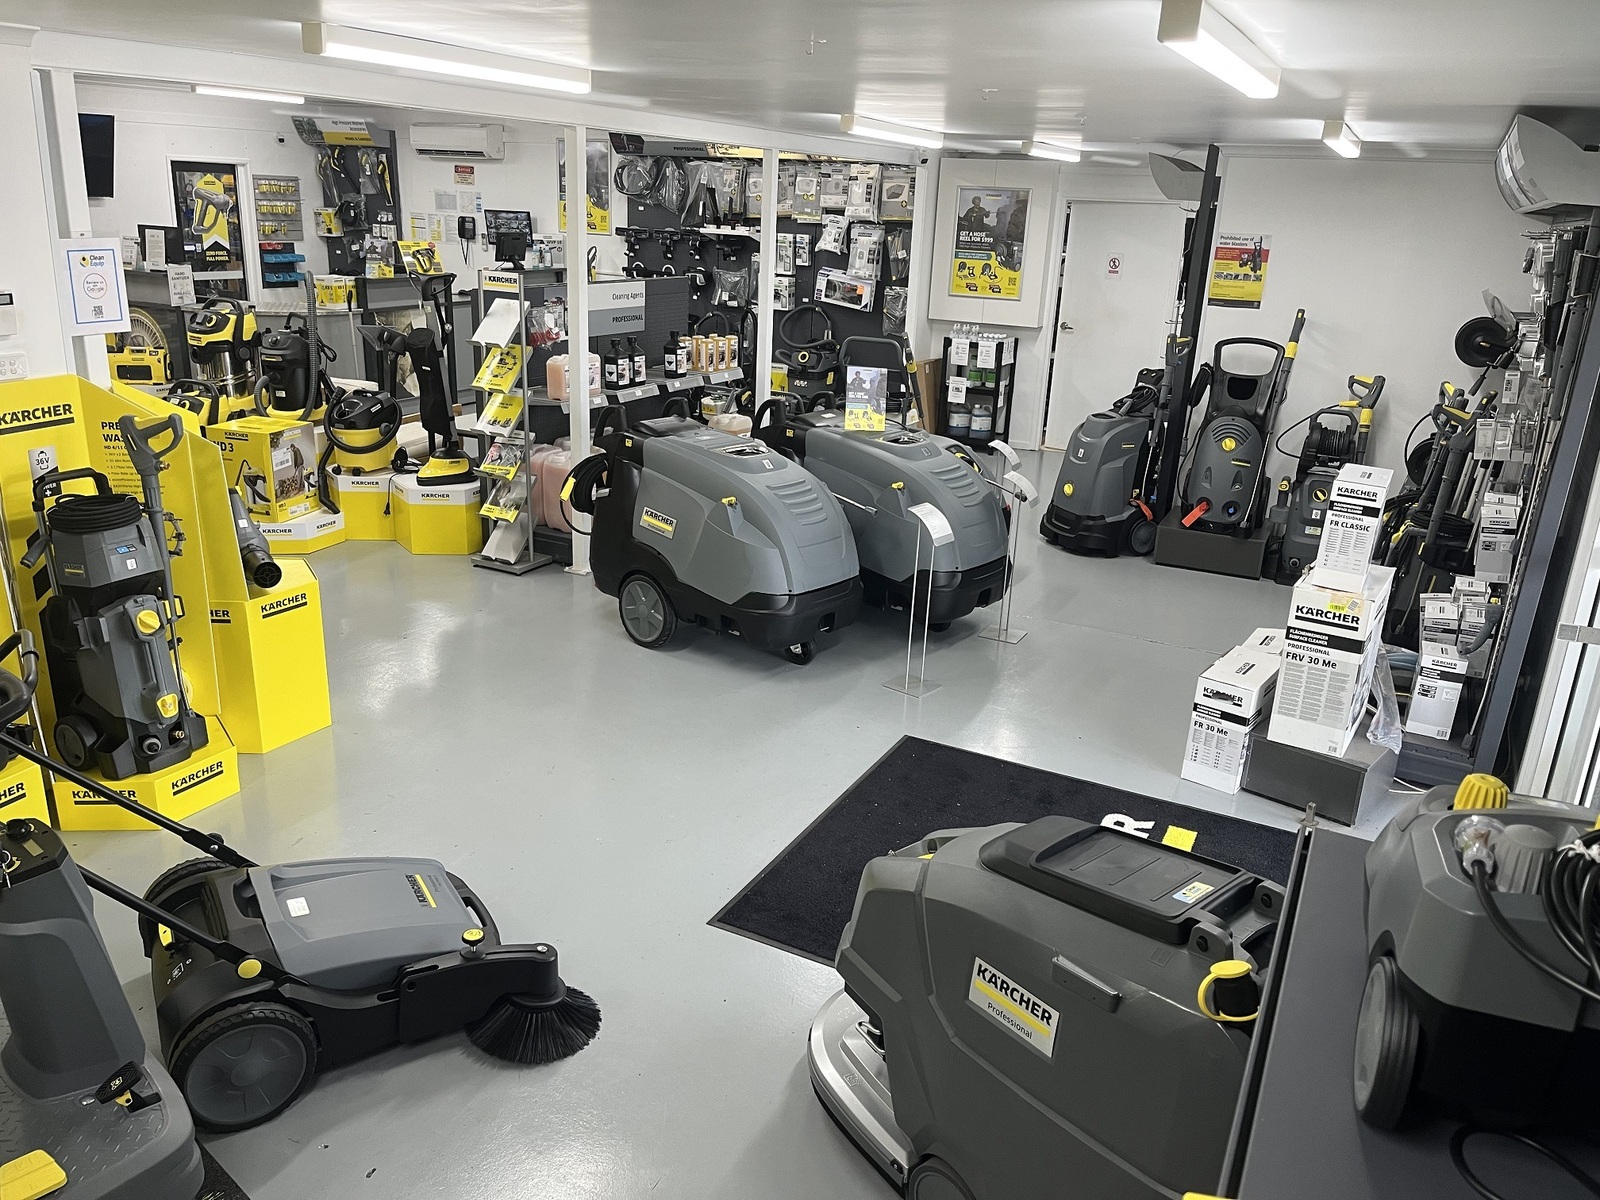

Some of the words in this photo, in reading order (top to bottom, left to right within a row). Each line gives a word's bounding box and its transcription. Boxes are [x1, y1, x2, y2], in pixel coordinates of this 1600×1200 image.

[612, 314, 643, 322] PROFESSIONAL
[0, 404, 72, 425] KÄRCHER
[101, 421, 120, 430] PRE
[102, 434, 124, 442] WA
[35, 456, 50, 466] 36V
[1338, 486, 1378, 498] KÄRCHER
[316, 520, 336, 529] KÄRCHER
[645, 509, 674, 526] KÄRCHER
[1332, 513, 1364, 522] PROFESSIONAL
[1341, 522, 1370, 532] CLASSIC
[261, 593, 306, 614] KÄRCHER
[1296, 605, 1360, 625] KÄRCHER
[1289, 634, 1308, 642] SURFACE
[1288, 642, 1330, 656] PROFESSIONAL
[1286, 652, 1304, 662] FRV
[1308, 656, 1320, 665] 30
[1322, 659, 1337, 668] Me
[1194, 720, 1204, 728] FR
[1206, 724, 1215, 732] 30
[1216, 728, 1228, 736] Me
[172, 762, 224, 790] KÄRCHER
[1100, 814, 1155, 838] R
[406, 874, 428, 902] KÄRCHER
[977, 964, 1052, 1026] KÄRCHER
[988, 1002, 1032, 1040] Professional
